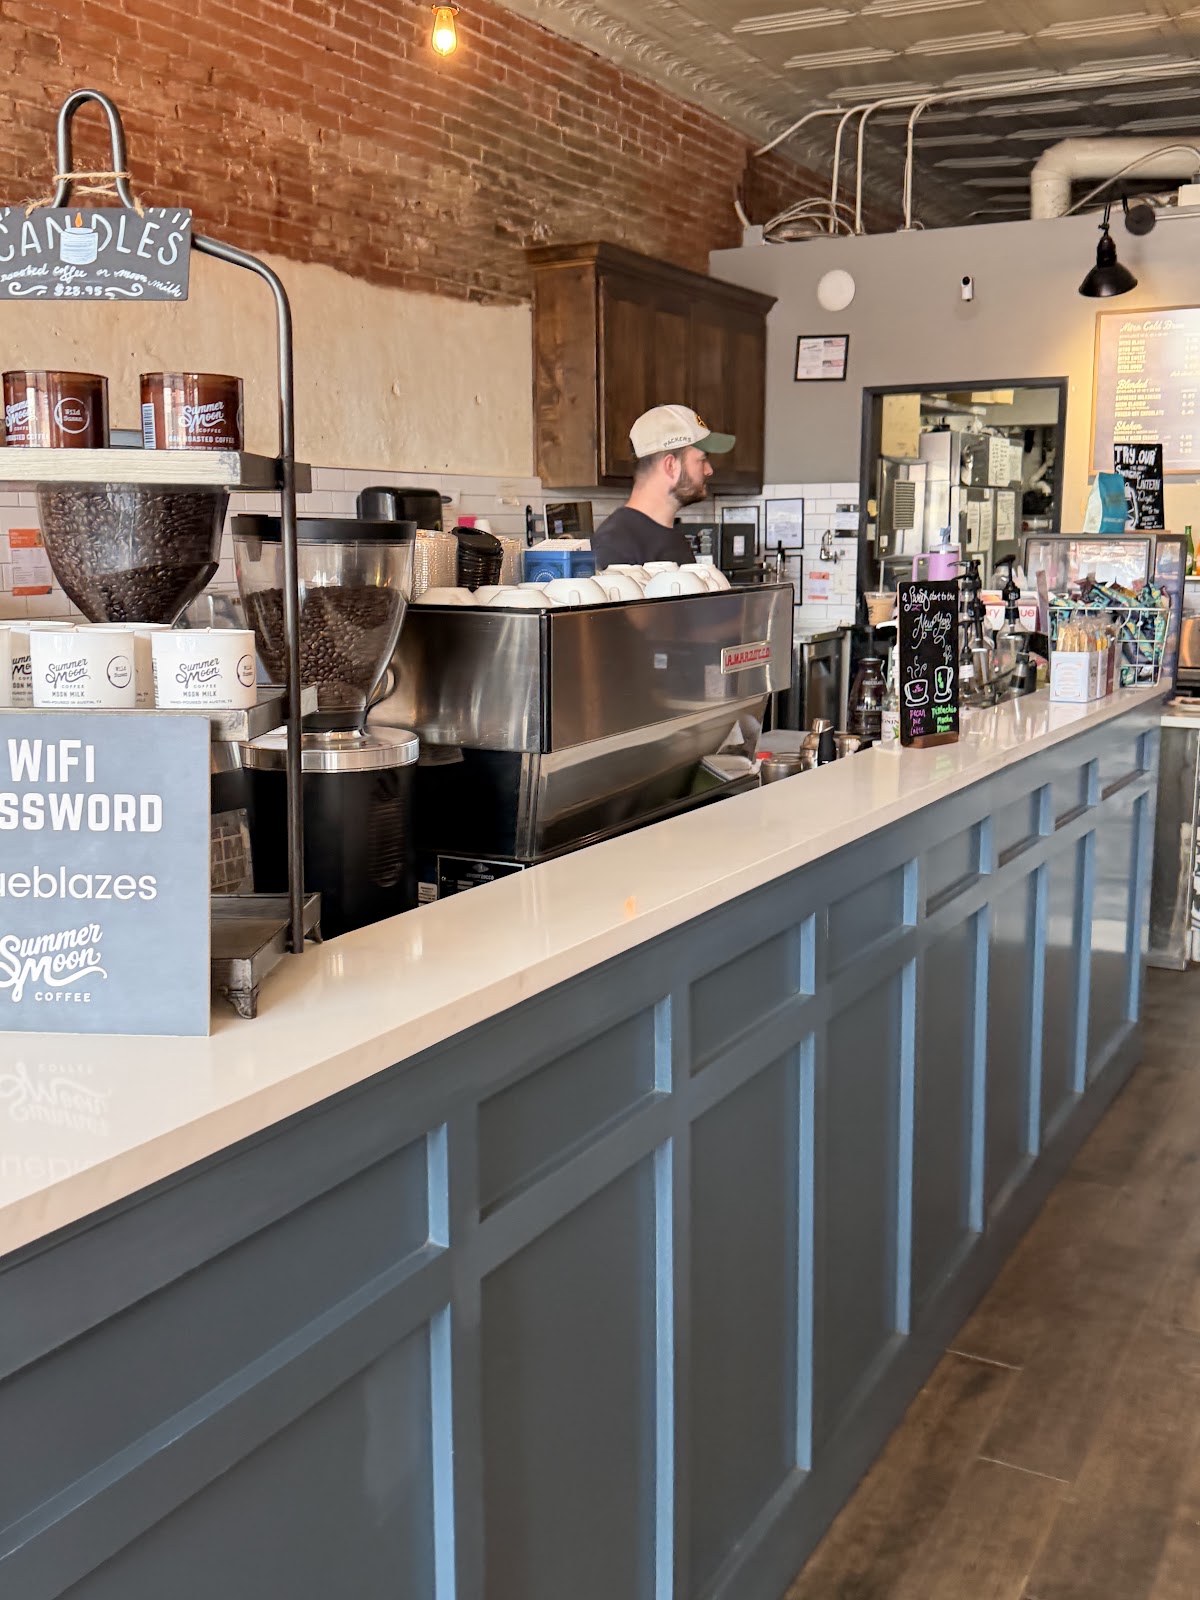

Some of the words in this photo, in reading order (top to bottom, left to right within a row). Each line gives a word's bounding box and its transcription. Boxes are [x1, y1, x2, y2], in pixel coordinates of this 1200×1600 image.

[52, 264, 88, 283] coffee
[96, 268, 111, 277] or
[147, 280, 183, 298] milk
[178, 401, 225, 428] Summer
[188, 411, 227, 433] Moon
[663, 436, 692, 448] PACKERS
[45, 658, 88, 684] Summer
[53, 668, 91, 689] Moon
[175, 658, 220, 684] Summer
[184, 667, 223, 689] Moon
[0, 922, 103, 989] Summer
[11, 946, 108, 1003] Moon
[34, 991, 92, 1003] COFFEE
